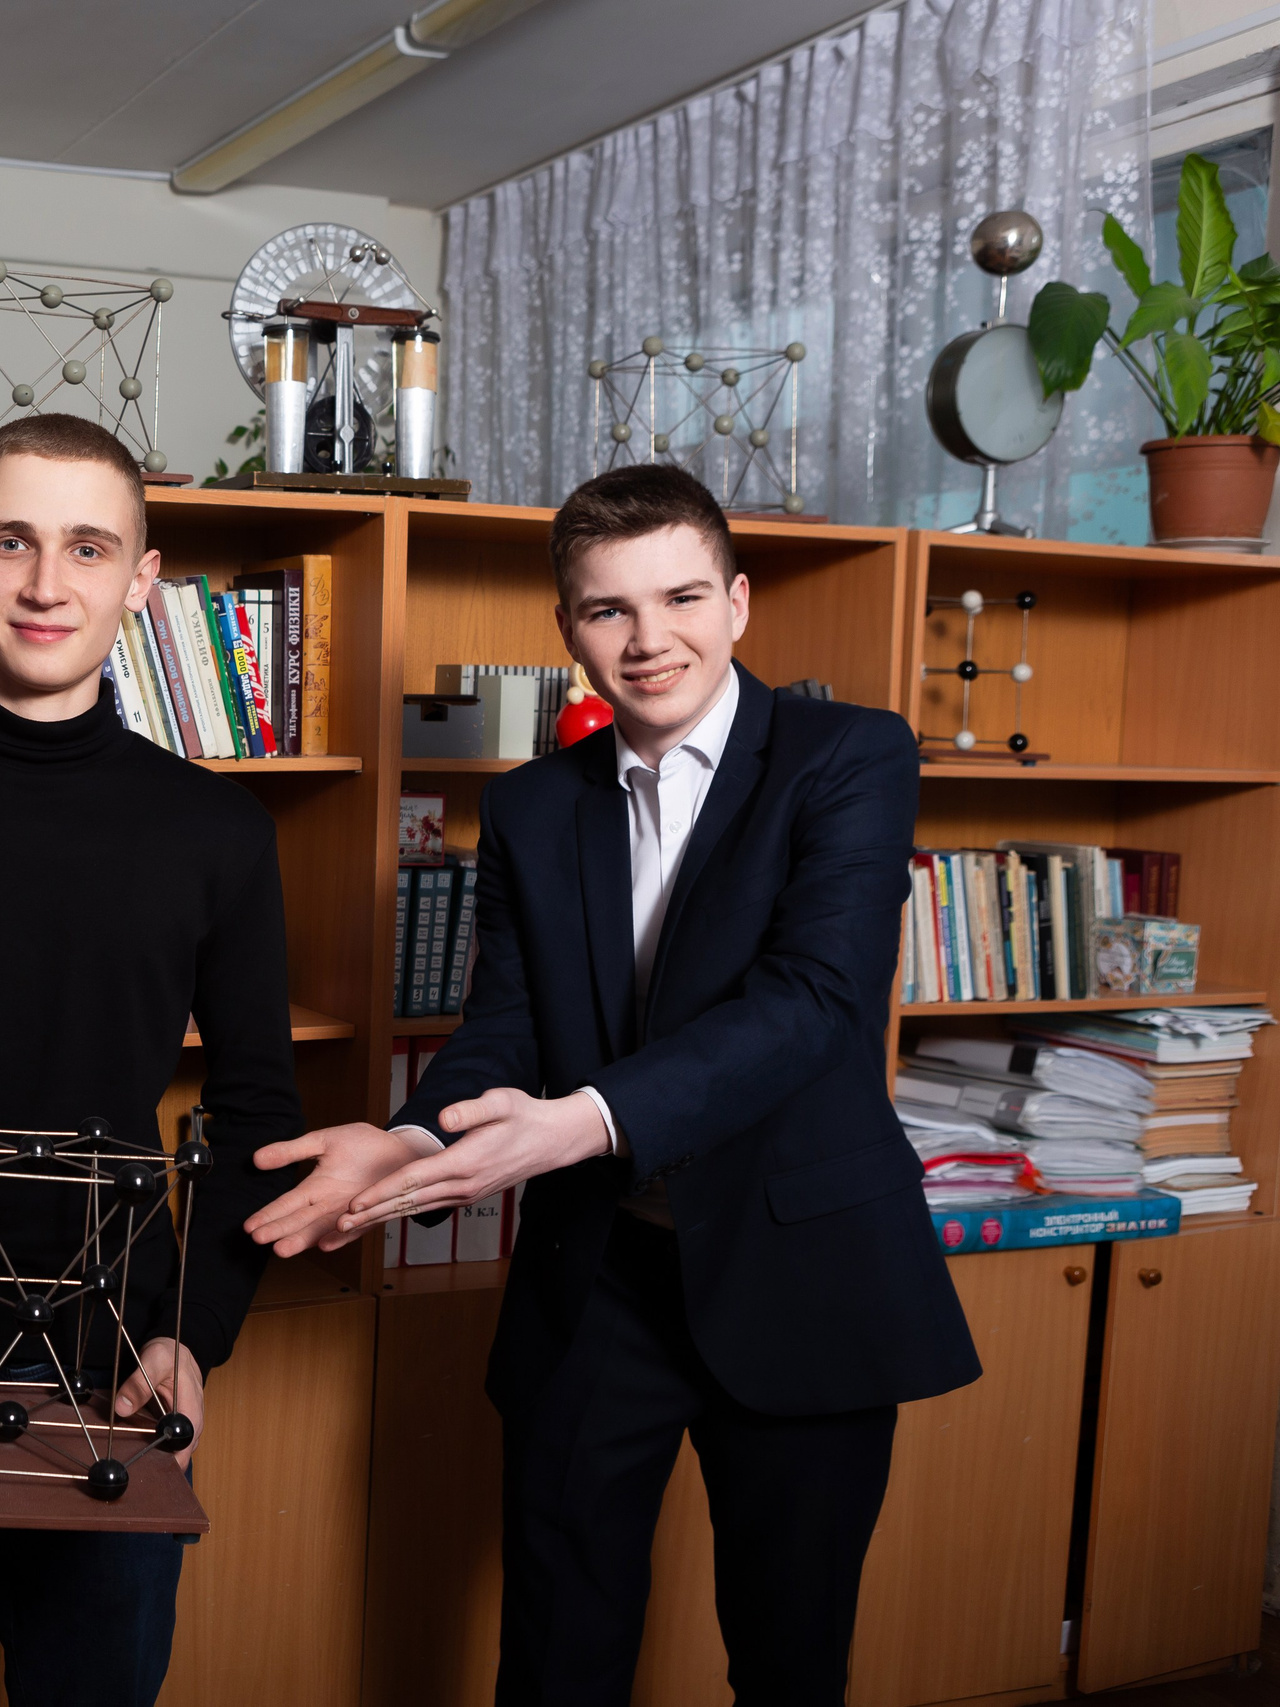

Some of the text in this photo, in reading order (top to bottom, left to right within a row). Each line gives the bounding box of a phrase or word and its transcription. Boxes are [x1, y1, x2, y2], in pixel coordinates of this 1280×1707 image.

[228, 603, 239, 639] ФИЗИКА
[249, 614, 255, 625] 6
[263, 623, 269, 633] 5
[190, 610, 210, 666] ФИЗИКА
[289, 587, 300, 684] КУРС ФИЗИКИ
[116, 639, 130, 679] ФИЗИКА
[157, 619, 190, 723] ФИЗИКА ВОКРУГ НАС
[236, 651, 247, 672] 1000
[241, 674, 253, 700] ЗАДАЧ
[133, 710, 142, 723] 11
[414, 897, 431, 984] ФИЗИКА
[431, 896, 447, 983] ФИЗИКА
[453, 895, 474, 981] ФИЗИКА
[414, 990, 420, 1000] 3
[477, 1207, 499, 1218] кл.
[1044, 1210, 1119, 1226] ЭЛЕКТРОННЫЙ
[1029, 1219, 1168, 1238] КОНСТРУКТОР ЗНАТОК
